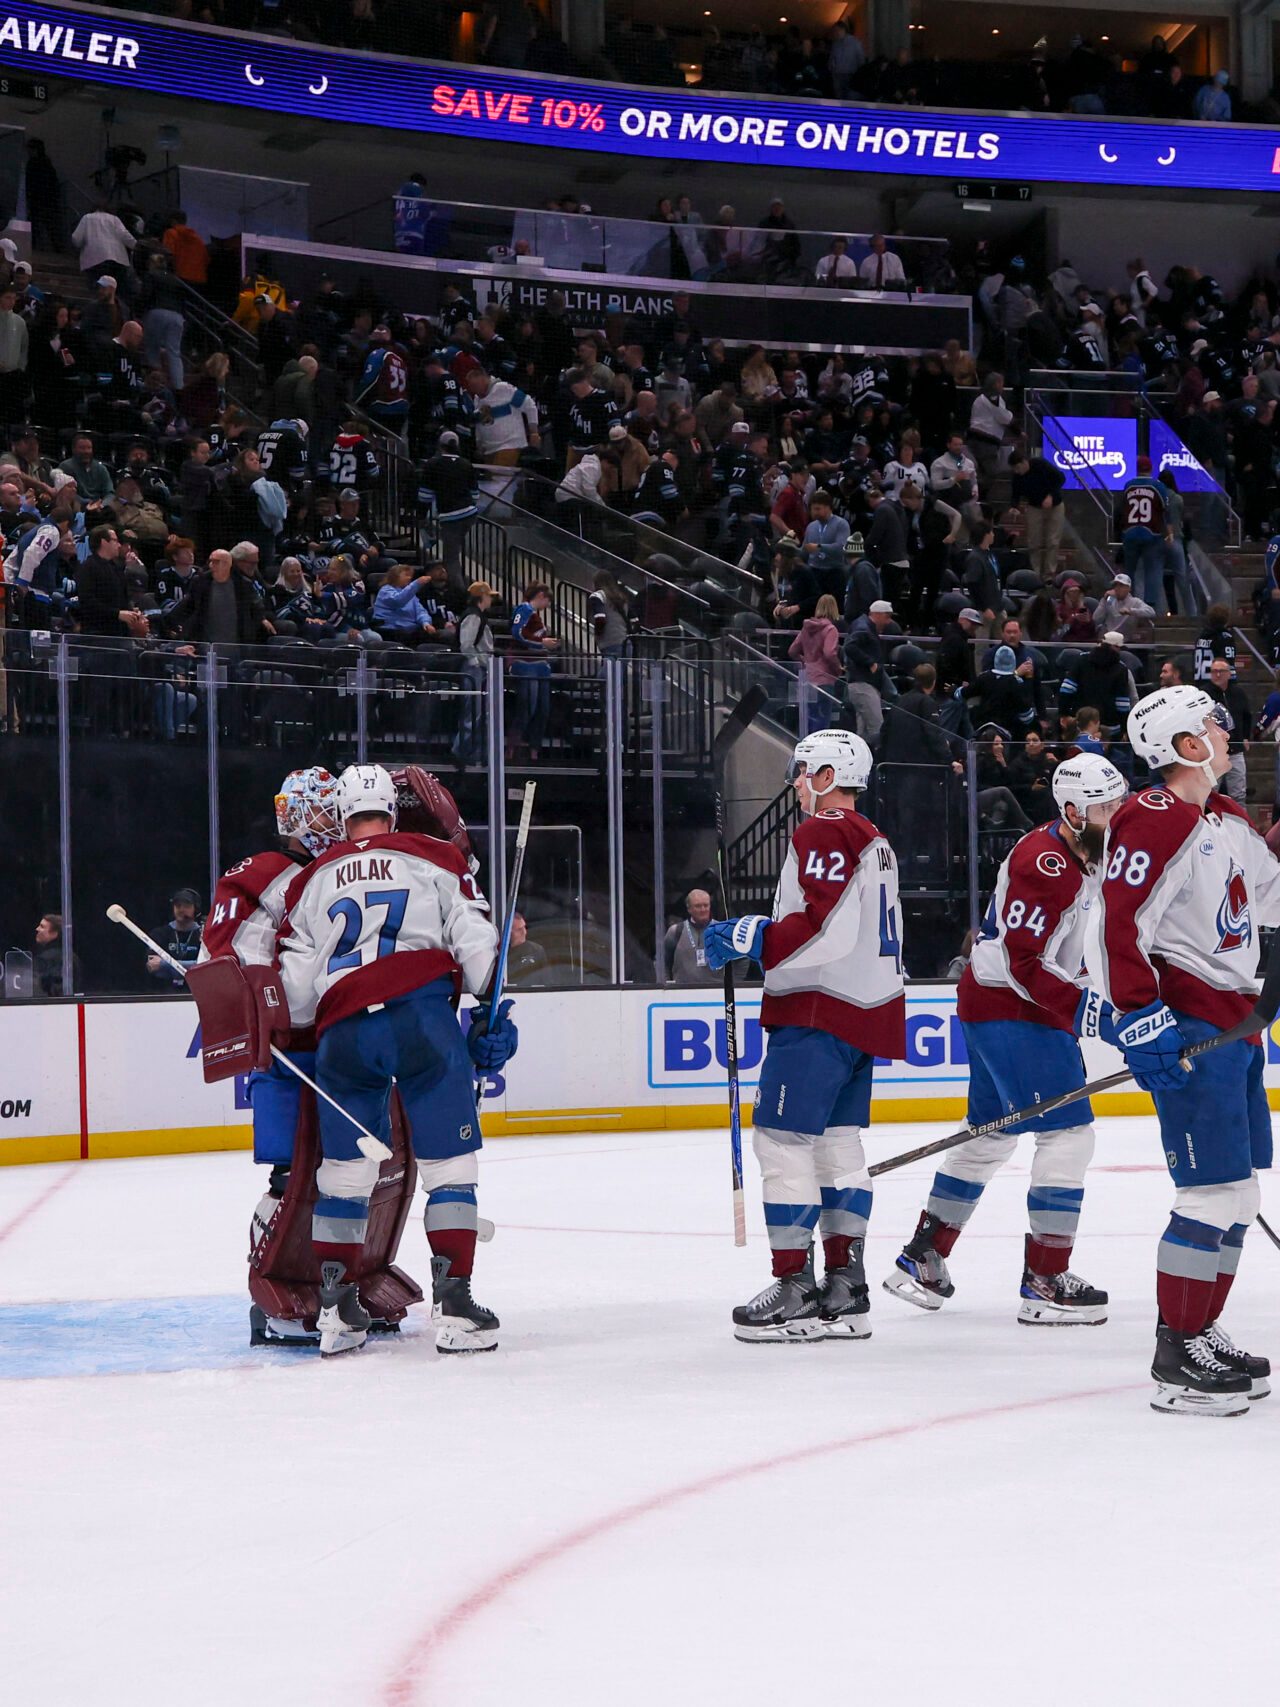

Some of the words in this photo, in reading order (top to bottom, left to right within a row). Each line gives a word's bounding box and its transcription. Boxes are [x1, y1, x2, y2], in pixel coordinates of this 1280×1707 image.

[34, 86, 46, 99] 16
[432, 86, 533, 124] SAVE
[541, 98, 606, 132] 10%
[620, 108, 672, 138] OR
[679, 113, 788, 147] MORE
[796, 121, 850, 151] ON
[857, 126, 1000, 160] HOTELS
[957, 185, 968, 196] 16
[990, 186, 996, 197] T
[1018, 188, 1030, 199] 17
[519, 286, 600, 311] HELTH
[1073, 436, 1105, 454] NITE
[732, 466, 746, 479] 77
[1054, 450, 1126, 479] CRAWLER
[1128, 498, 1153, 525] 29
[1134, 697, 1168, 721] Kiewit
[363, 778, 375, 789] 27
[1058, 768, 1082, 779] Kiewit
[1101, 767, 1115, 778] 84
[1107, 781, 1122, 792] CCM
[336, 859, 394, 890] KULAK
[804, 850, 848, 882] 42
[1107, 844, 1152, 887] 88
[211, 896, 239, 926] 41
[1005, 898, 1047, 939] 84
[327, 888, 410, 976] 27
[1086, 992, 1100, 1038] CCM
[1125, 1008, 1177, 1047] BAUE
[726, 1012, 736, 1062] BAUER
[1182, 1037, 1221, 1058] LYLITE
[204, 1042, 248, 1059] TRUE
[777, 1084, 787, 1117] BAUER
[977, 1110, 1022, 1135] BAUER
[1185, 1132, 1197, 1170] BAUER
